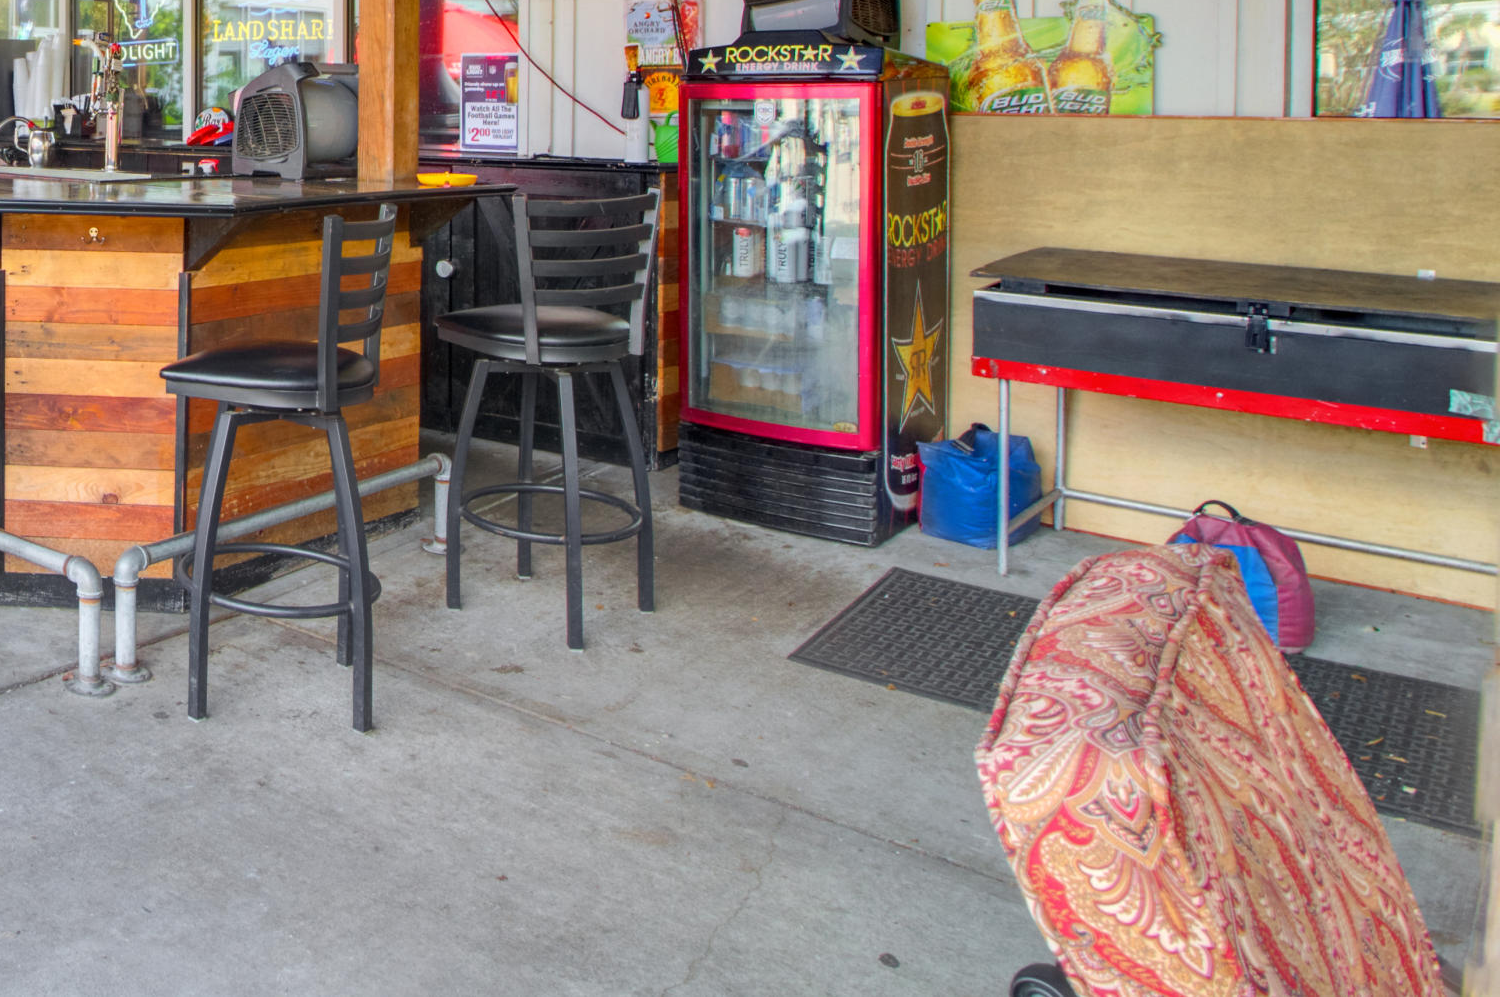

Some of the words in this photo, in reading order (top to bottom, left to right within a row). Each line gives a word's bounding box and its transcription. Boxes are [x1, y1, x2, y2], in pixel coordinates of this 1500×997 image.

[628, 27, 666, 35] ORCHARD
[633, 20, 661, 29] ANGRY
[129, 43, 177, 61] LIGHT
[250, 39, 300, 66] Lager
[639, 47, 673, 67] ANGRY
[725, 44, 834, 64] ROCKSTAR
[735, 62, 779, 72] ENERGY
[783, 61, 819, 72] DRINK
[992, 93, 1045, 111] BUD
[1059, 91, 1106, 104] BUD
[482, 118, 500, 126] Here!
[739, 237, 749, 268] TRULY
